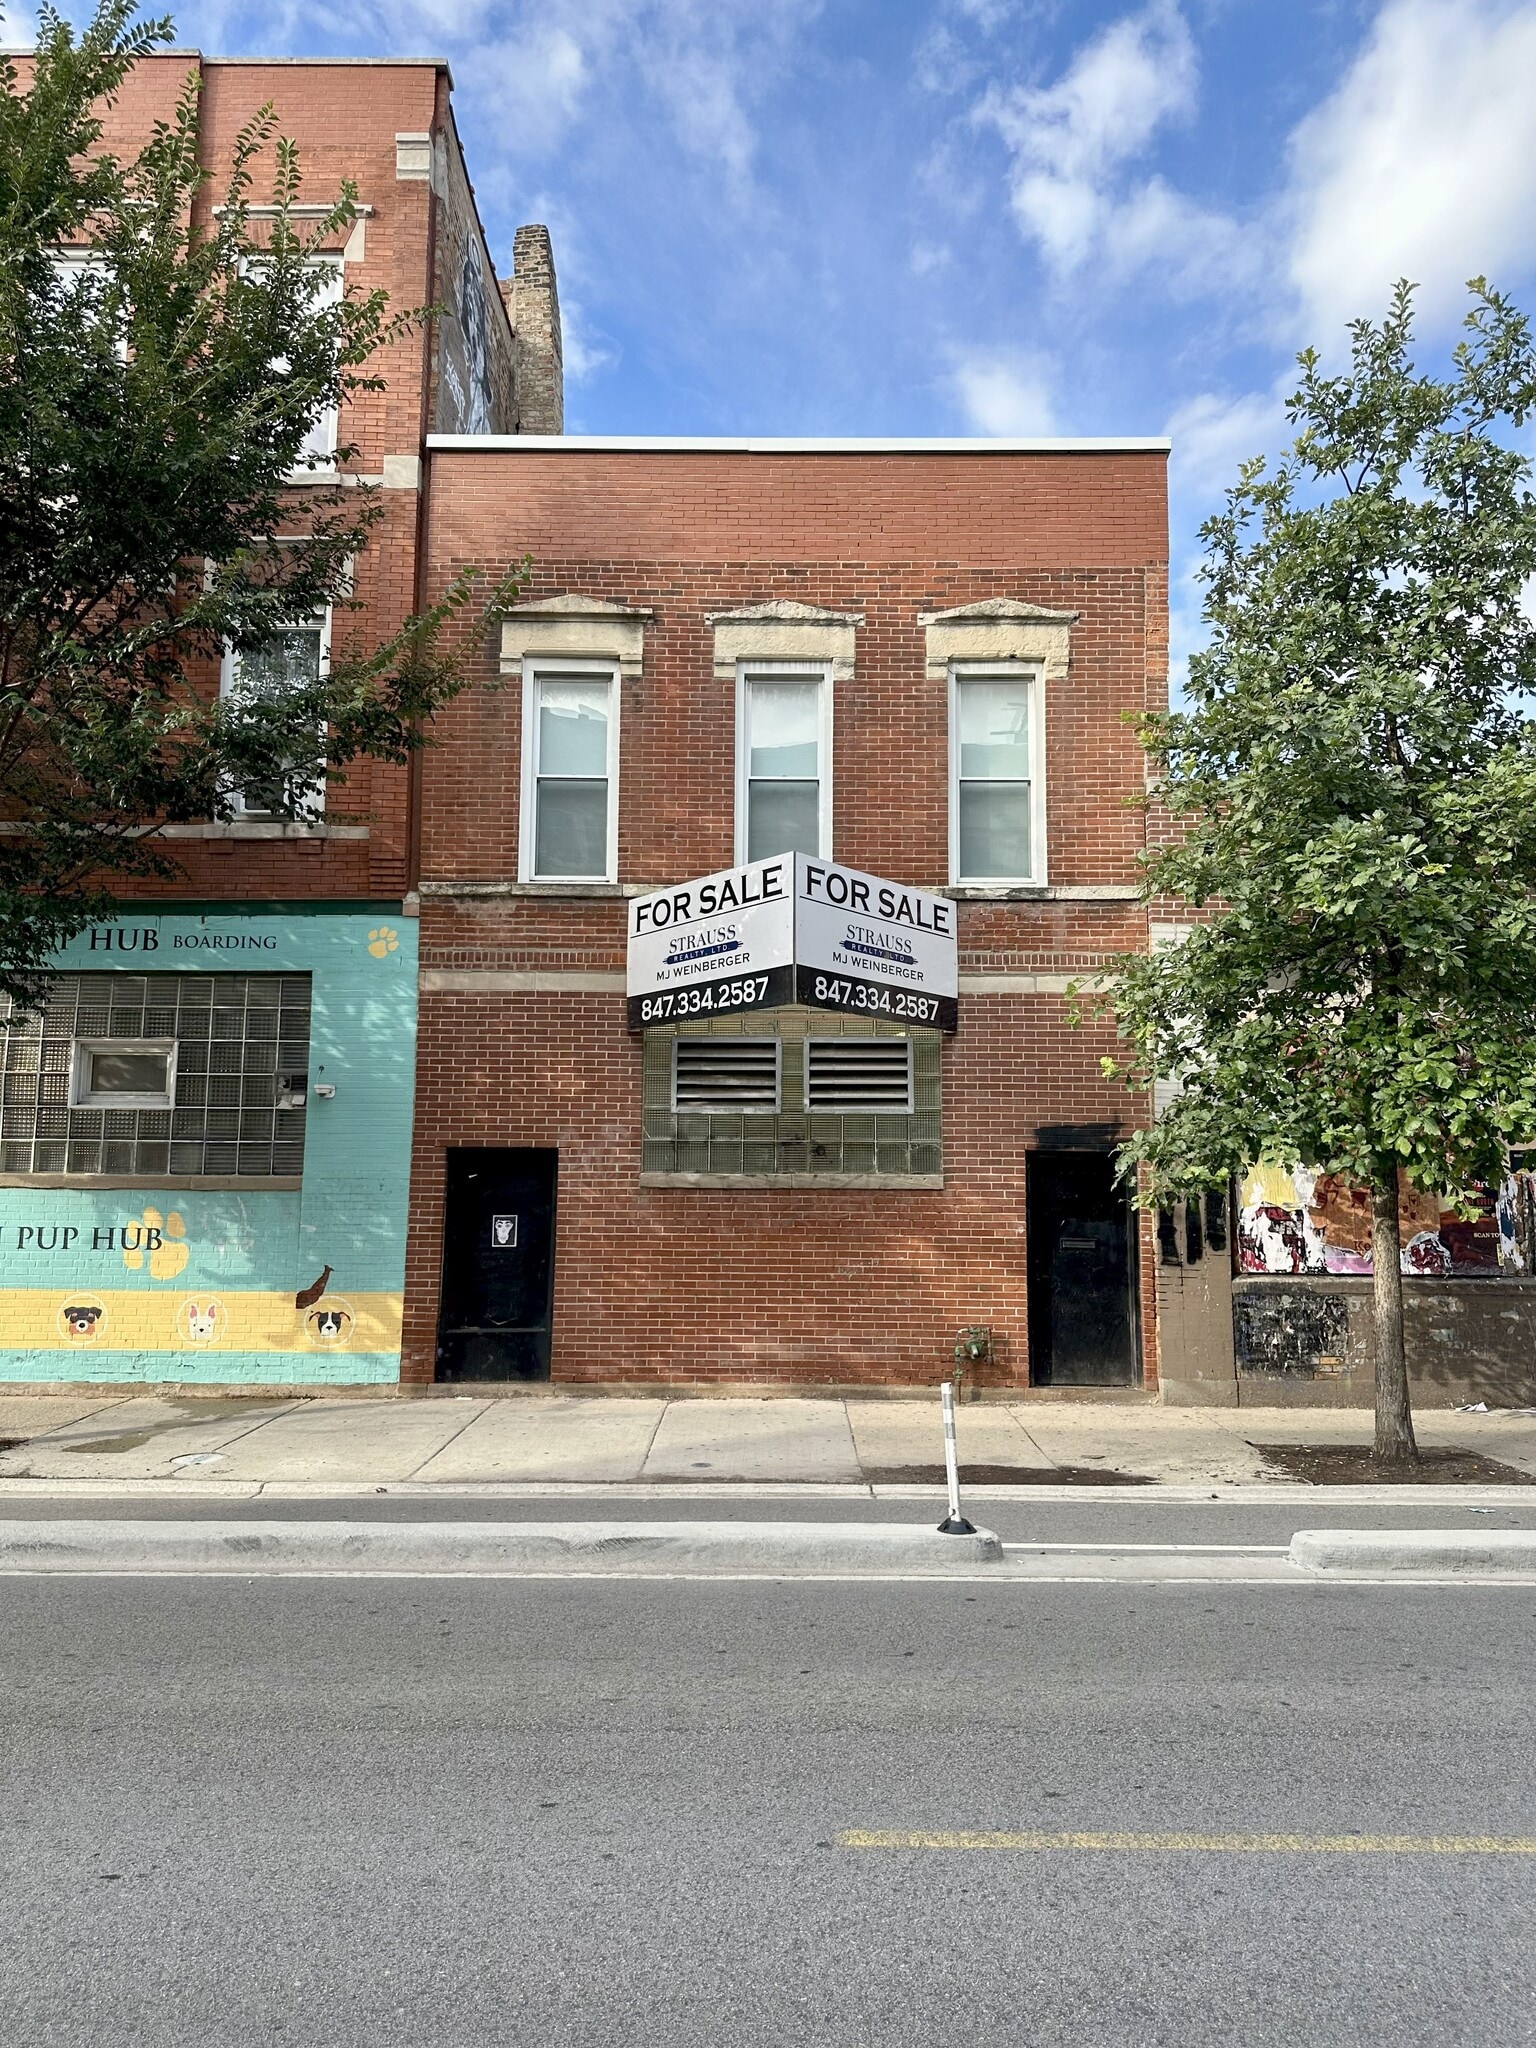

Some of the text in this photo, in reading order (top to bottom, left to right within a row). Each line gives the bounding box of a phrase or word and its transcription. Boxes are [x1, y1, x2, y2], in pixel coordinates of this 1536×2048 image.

[636, 864, 783, 932] FOR SALE
[806, 865, 949, 934] FOR SALE
[89, 928, 159, 951] HUB
[173, 935, 277, 949] BOARDING
[669, 924, 736, 954] STRAUSS
[846, 924, 912, 954] STRAUSS
[656, 952, 750, 981] MJ WEINBERGER
[832, 951, 924, 982] MJ WEINBERGER
[641, 976, 769, 1021] 847.334.2587
[815, 976, 939, 1021] 847.334.2587
[16, 1226, 163, 1251] PUP HUB
